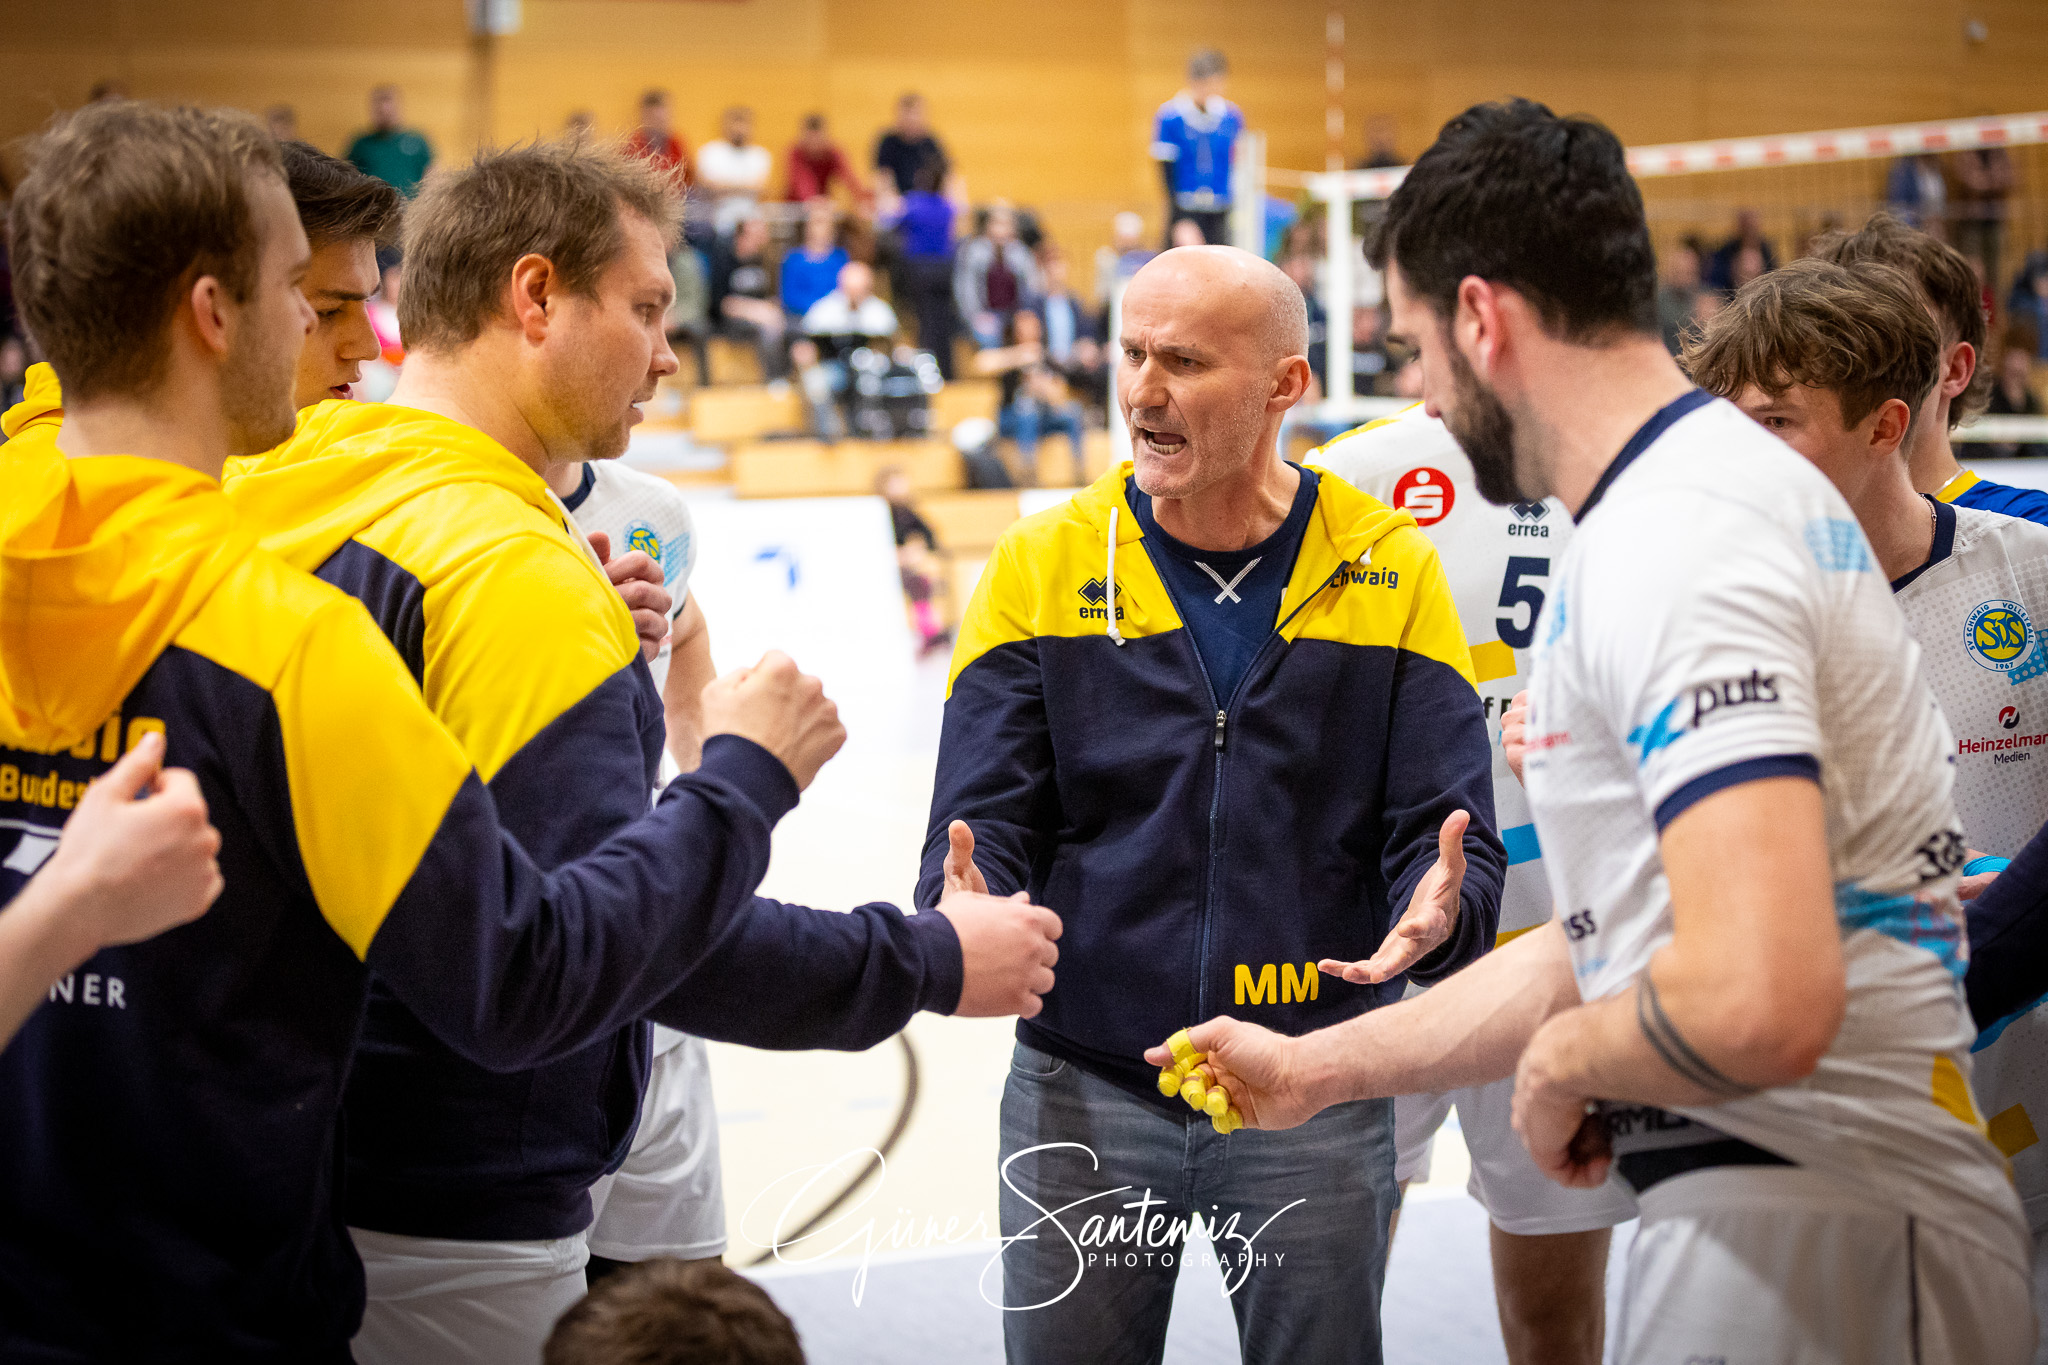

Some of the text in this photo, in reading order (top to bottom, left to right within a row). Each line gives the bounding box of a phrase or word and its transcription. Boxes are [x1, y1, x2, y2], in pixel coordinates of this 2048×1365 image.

[1508, 523, 1549, 538] errea
[1329, 566, 1399, 589] chwaig
[1495, 555, 1551, 649] 5
[1966, 604, 1990, 638] SCHWAIG
[2002, 602, 2035, 645] VOLLEYBALL
[1995, 661, 2014, 670] 1967
[1994, 750, 2031, 765] Medien
[49, 972, 127, 1011] NER
[1234, 961, 1319, 1006] MM
